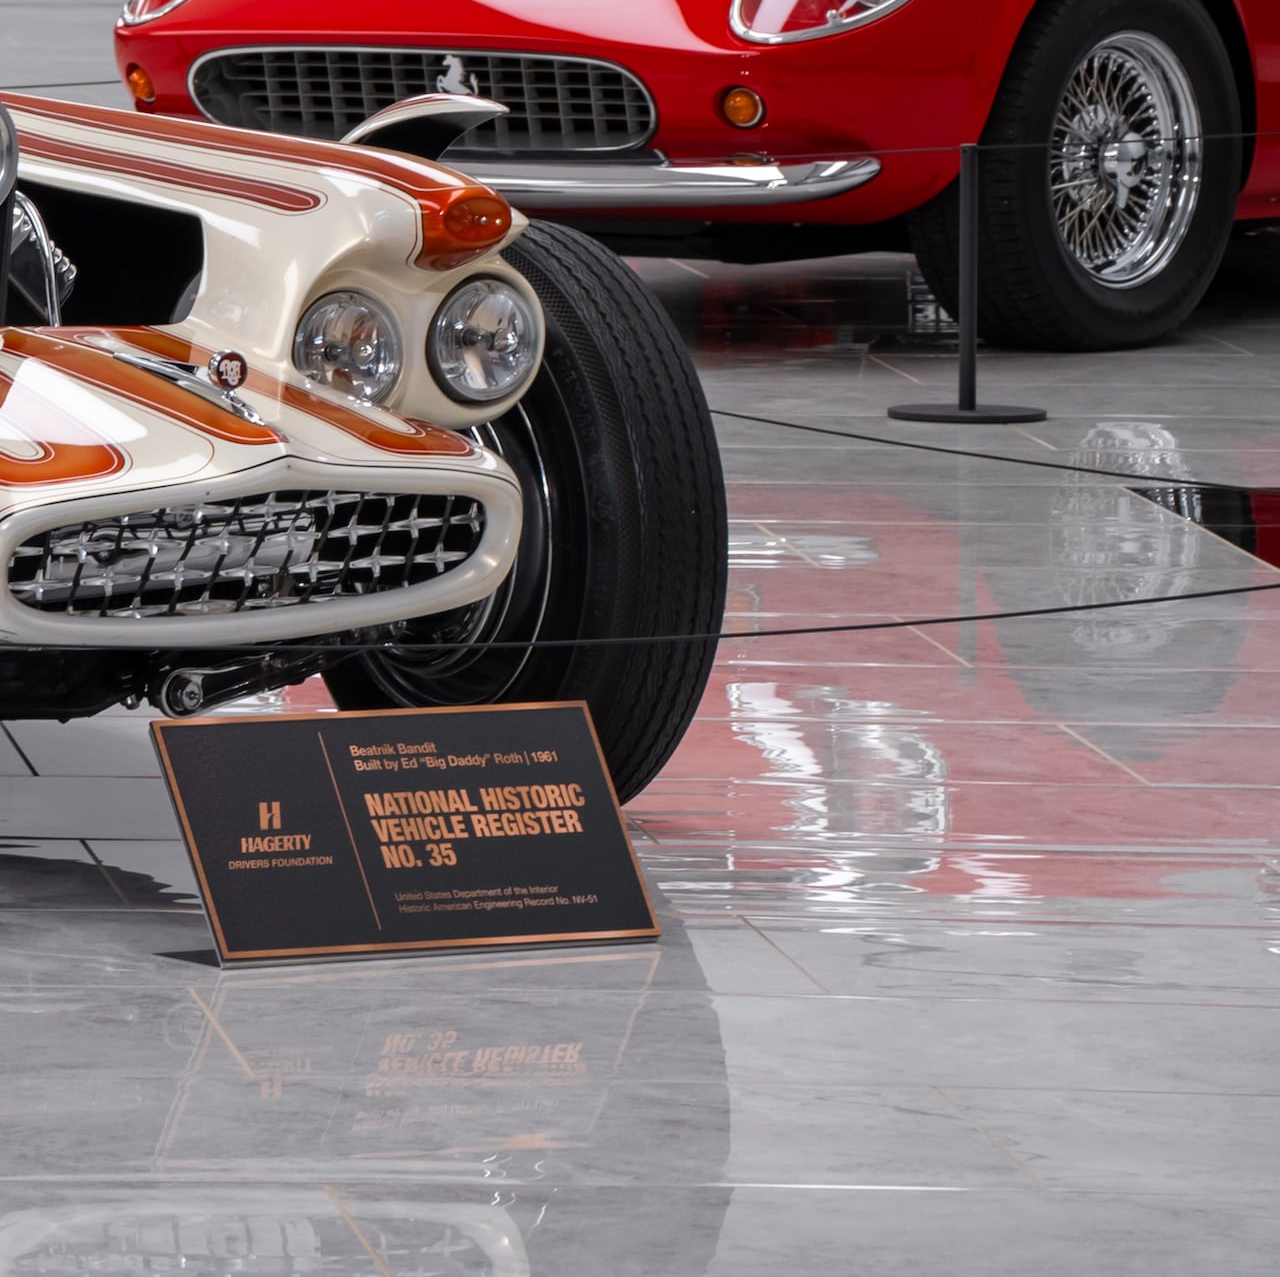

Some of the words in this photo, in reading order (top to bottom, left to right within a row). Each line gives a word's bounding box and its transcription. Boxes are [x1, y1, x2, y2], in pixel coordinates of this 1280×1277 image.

[349, 744, 394, 757] Beatnik
[397, 742, 437, 755] Bandit
[354, 758, 382, 772] Built
[384, 758, 399, 772] by
[401, 757, 418, 769] Ed
[494, 751, 523, 765] Roth
[531, 750, 559, 764] 1961
[364, 789, 479, 817] NATIONAL
[479, 783, 586, 811] HISTORIC
[370, 814, 469, 843] VEHICLE
[471, 809, 584, 838] REGISTER
[241, 834, 311, 853] HAGERTY
[228, 859, 270, 870] DRIVERS
[272, 855, 333, 868] FOUNDATION
[380, 844, 423, 869] NO.
[425, 842, 458, 867] 35
[395, 891, 423, 902] United
[424, 890, 452, 900] States
[453, 887, 503, 899] Department
[504, 886, 513, 895] of
[514, 886, 528, 895] the
[529, 885, 559, 894] Interior
[398, 903, 432, 914] Historic
[433, 902, 472, 912] American
[473, 899, 523, 911] Engineering
[523, 897, 555, 907] Record
[556, 896, 571, 906] No.
[572, 894, 599, 905] NV-51
